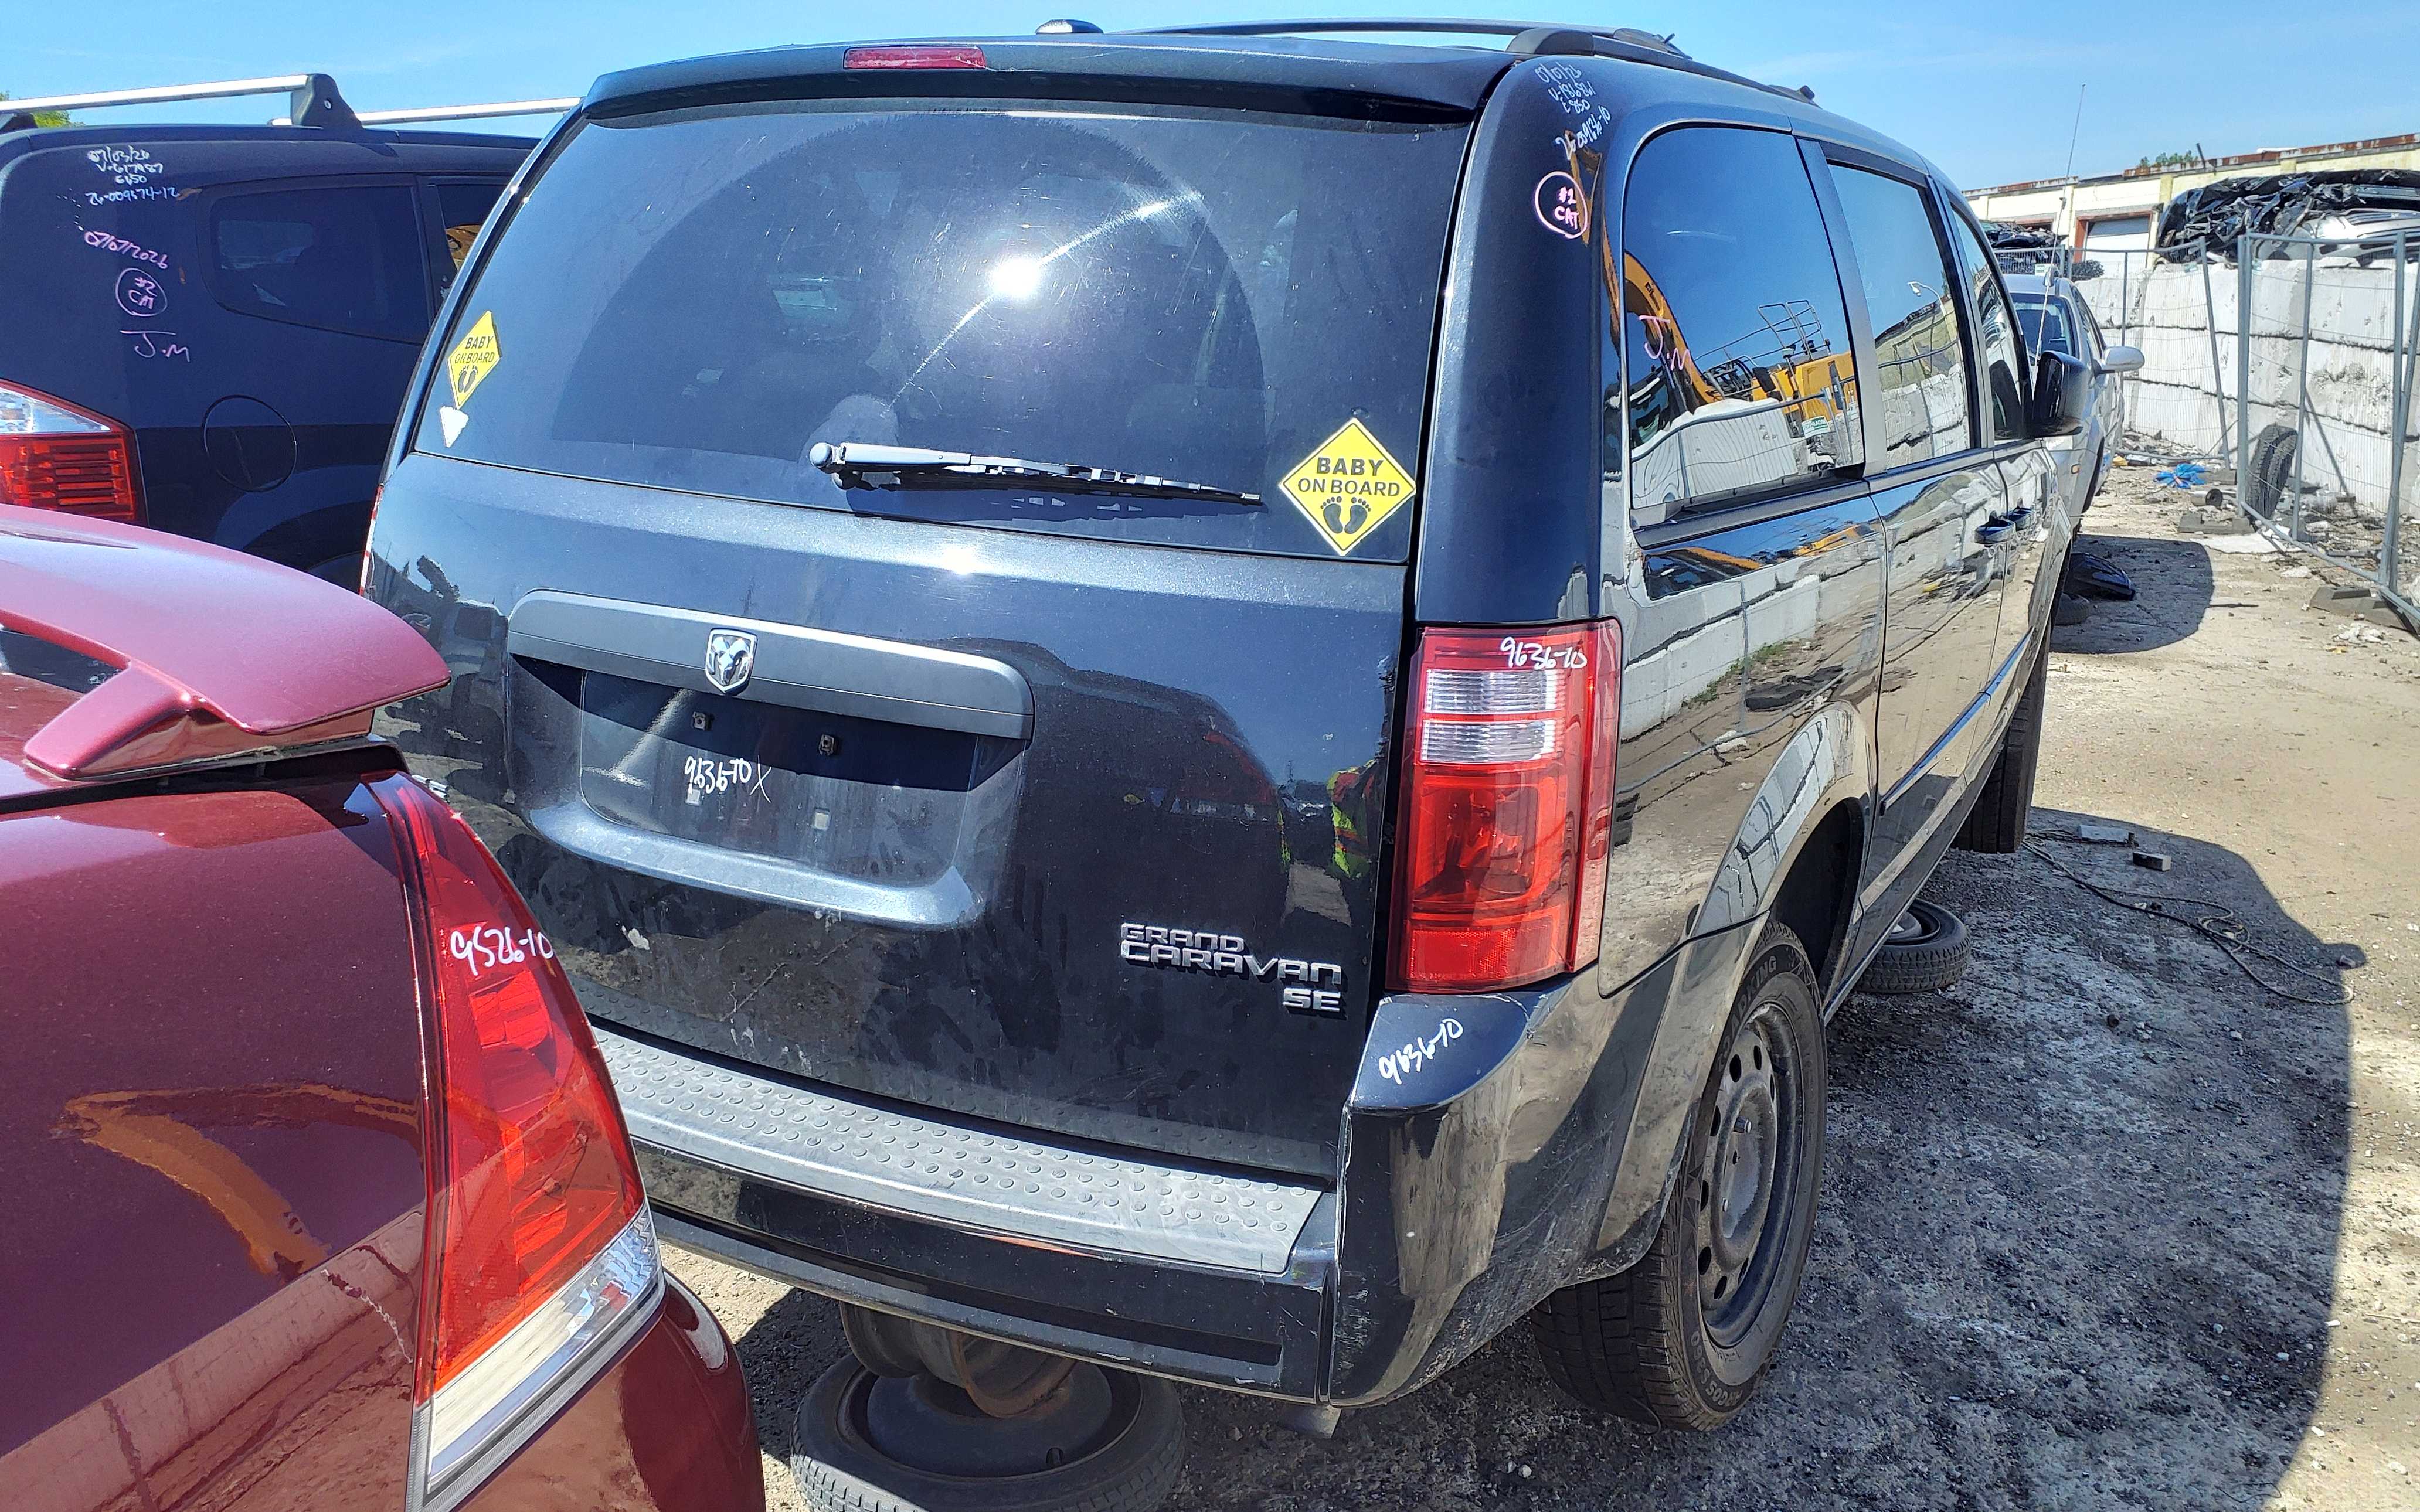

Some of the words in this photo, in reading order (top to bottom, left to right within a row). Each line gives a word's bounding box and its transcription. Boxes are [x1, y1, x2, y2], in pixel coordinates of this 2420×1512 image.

[1554, 206, 1579, 229] CAT
[465, 335, 494, 350] BABY
[454, 353, 467, 364] ON
[467, 352, 495, 363] BOARD
[1316, 457, 1384, 476] BABY
[1297, 478, 1325, 493] ON
[1330, 479, 1401, 496] BOARD
[1501, 636, 1588, 670] 9636-10
[685, 755, 752, 794] 9636-10
[1121, 922, 1245, 953] GRAND
[450, 926, 554, 976] 9526-10
[1121, 939, 1341, 985] CARAVAN
[1283, 987, 1341, 1012] SE
